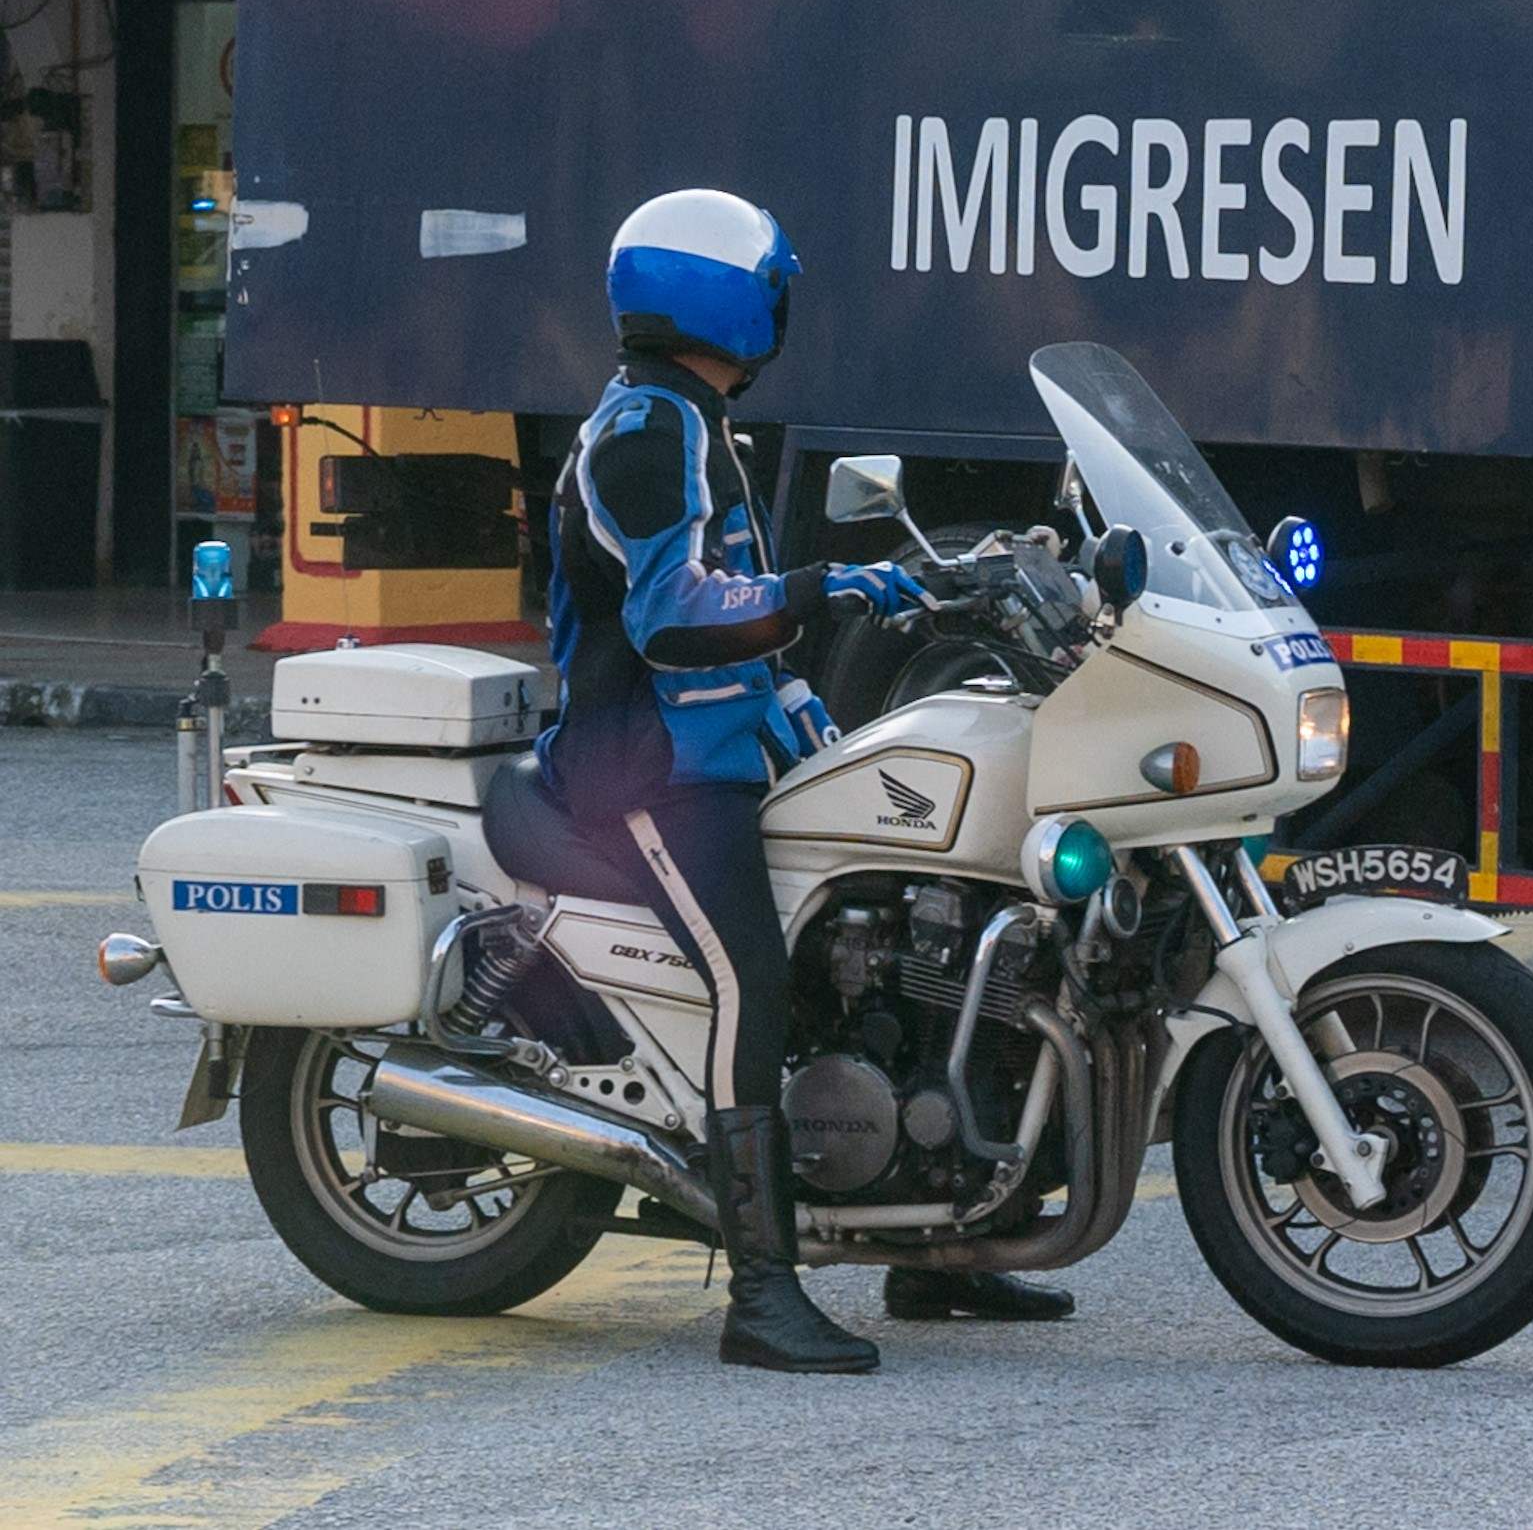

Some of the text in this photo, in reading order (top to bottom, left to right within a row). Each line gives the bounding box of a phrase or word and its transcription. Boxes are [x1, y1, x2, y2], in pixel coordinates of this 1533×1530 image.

[890, 113, 1468, 285] IMIGRESEN
[721, 585, 765, 610] JSPT
[877, 815, 937, 831] HONDA
[1293, 849, 1458, 894] WSH5654
[186, 884, 283, 912] POLIS
